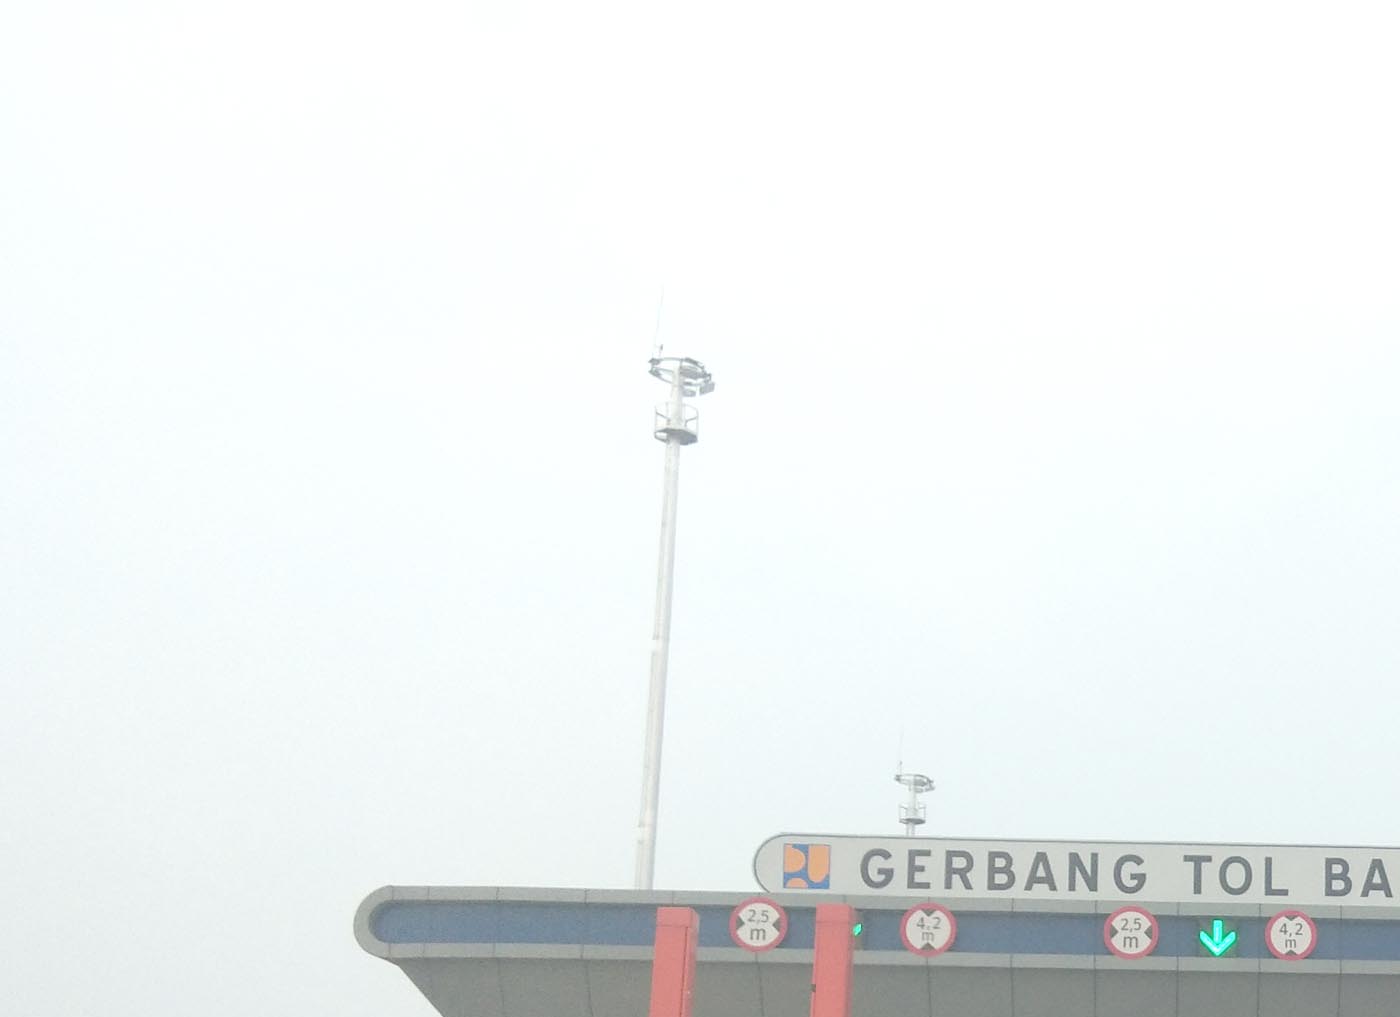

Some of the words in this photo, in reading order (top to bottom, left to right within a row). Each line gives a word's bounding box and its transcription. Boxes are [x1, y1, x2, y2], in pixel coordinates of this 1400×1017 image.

[859, 847, 1147, 893] GERBANG
[1184, 853, 1289, 897] TOL
[747, 909, 769, 925] 2,5
[1121, 918, 1142, 933] 2,5
[1279, 923, 1303, 938] 4,2
[750, 928, 766, 940] m
[922, 931, 935, 942] m
[1123, 936, 1139, 948] m
[1285, 939, 1297, 949] m
